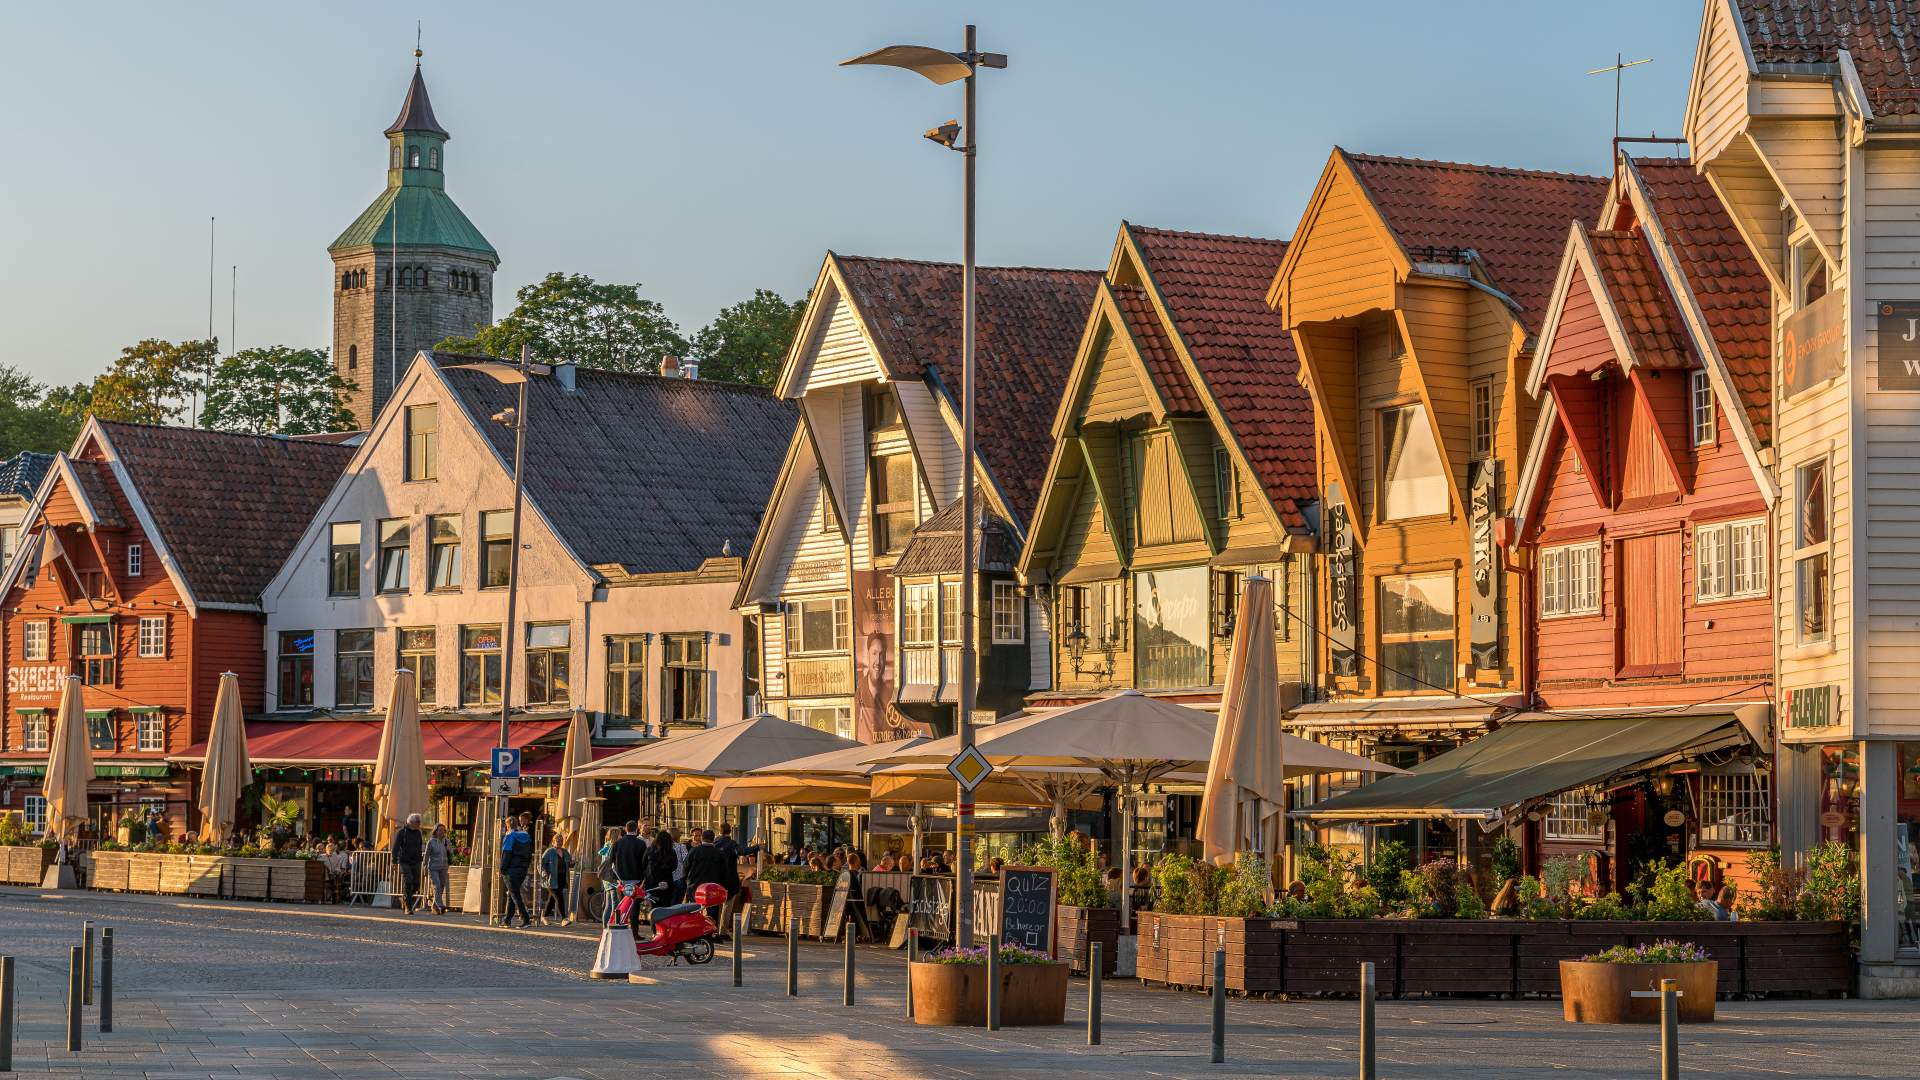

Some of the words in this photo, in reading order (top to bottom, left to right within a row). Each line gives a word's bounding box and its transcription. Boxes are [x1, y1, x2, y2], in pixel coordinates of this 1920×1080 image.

[1333, 502, 1351, 632] backstage
[866, 587, 885, 600] ALLE
[498, 752, 513, 773] P
[1006, 897, 1045, 915] 20:00
